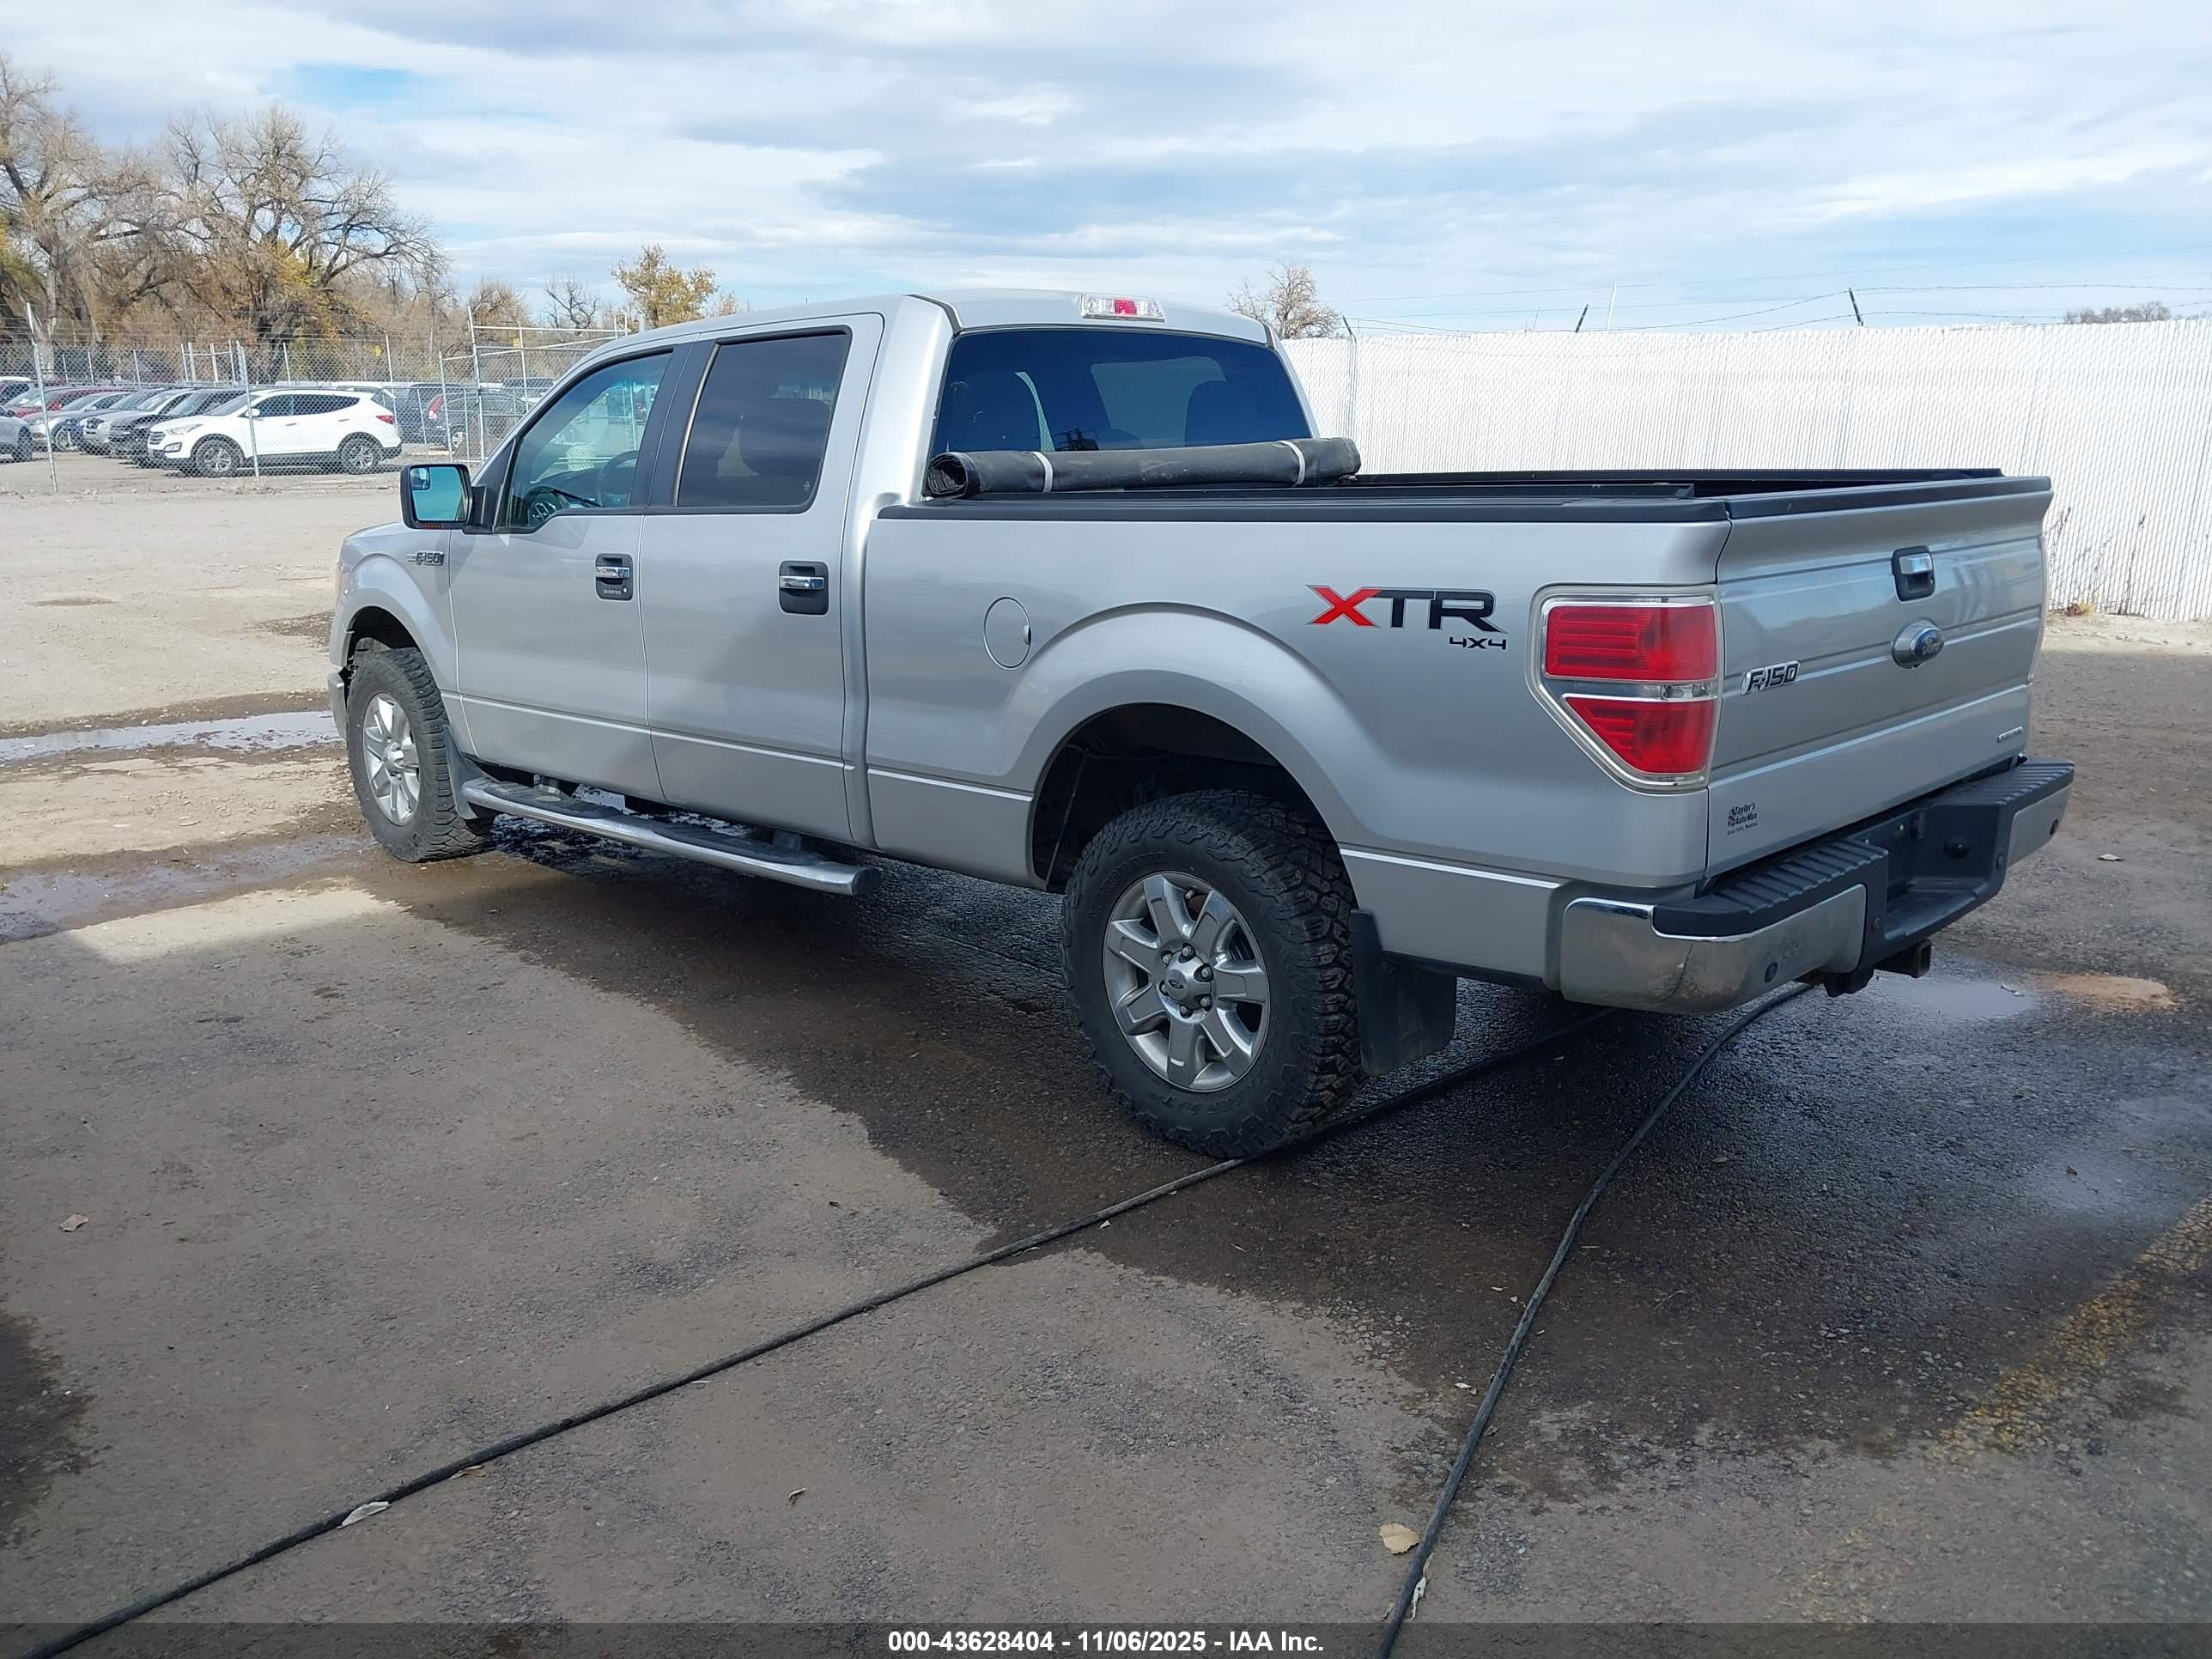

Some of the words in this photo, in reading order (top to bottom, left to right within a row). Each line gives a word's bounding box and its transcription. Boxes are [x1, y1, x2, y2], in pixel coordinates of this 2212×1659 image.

[416, 550, 444, 566] F-150
[1305, 585, 1509, 634] XTR
[1741, 660, 1801, 694] F-150
